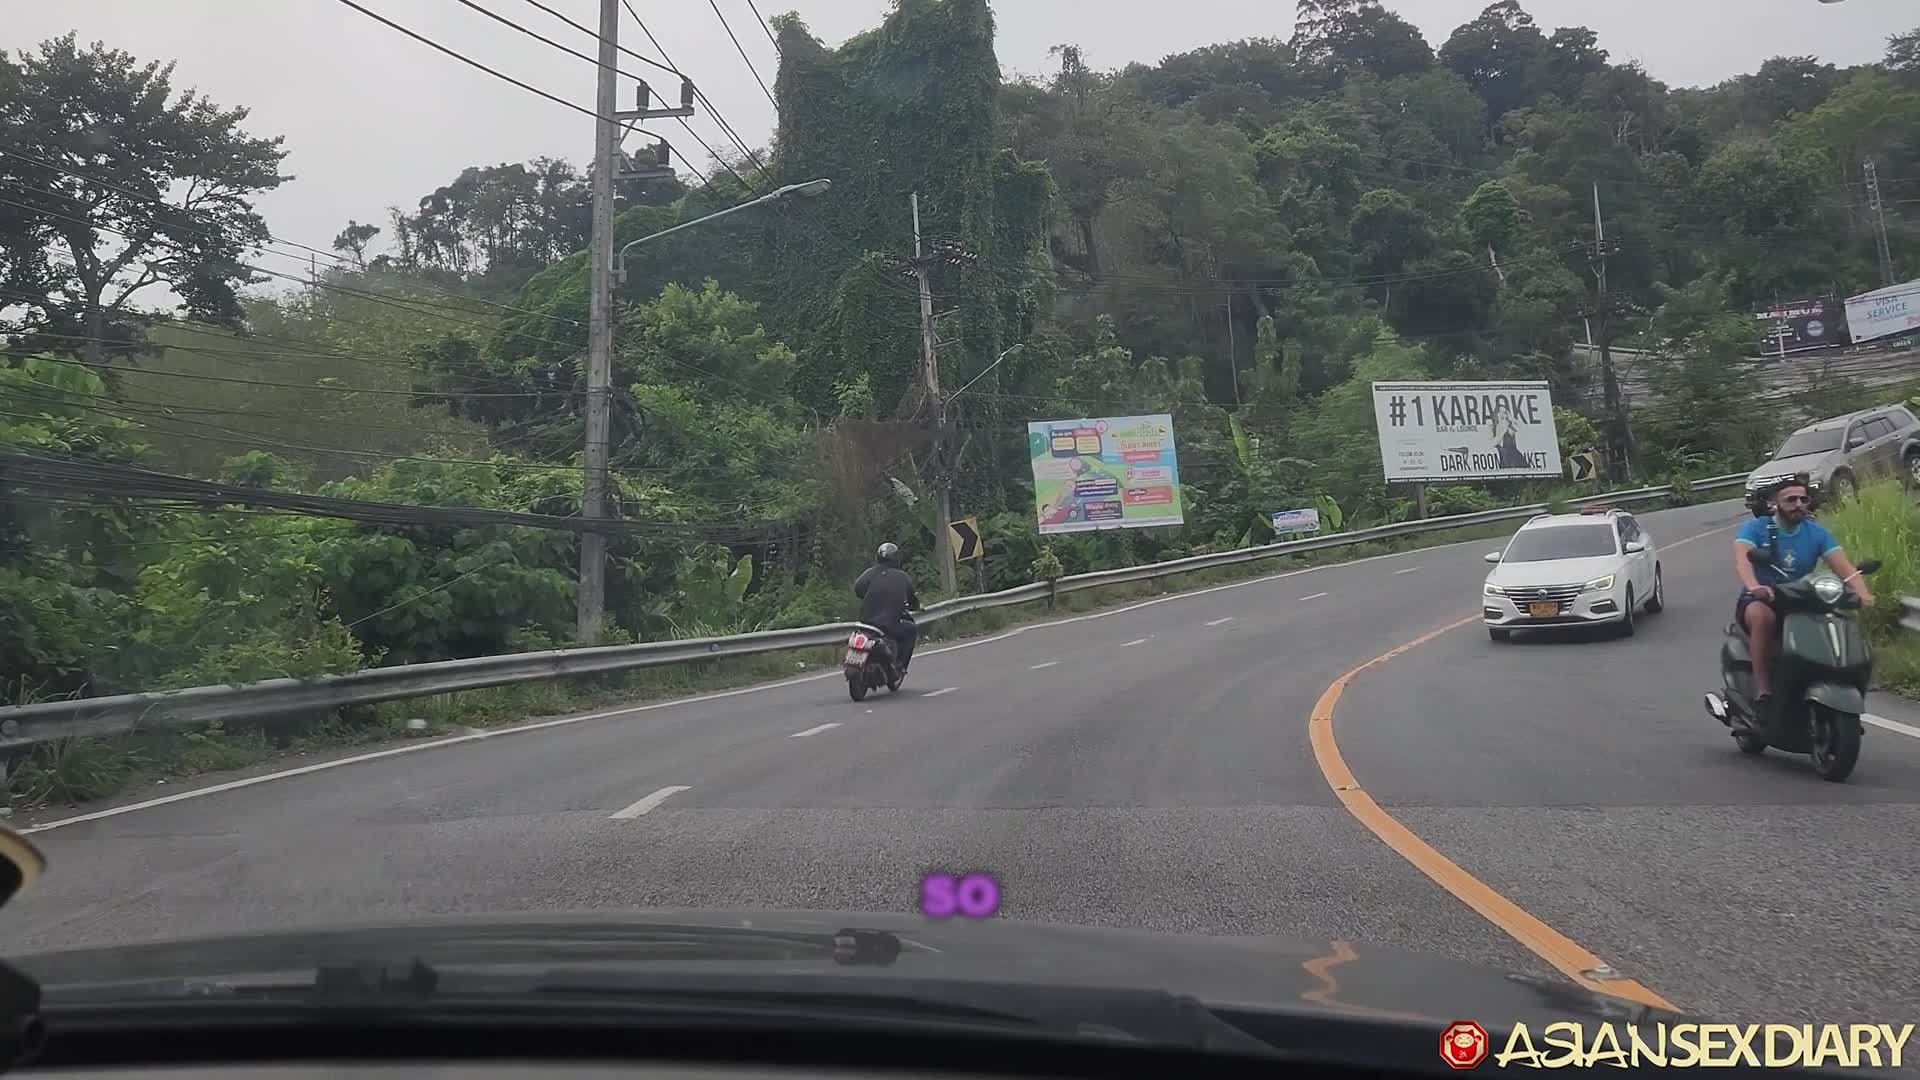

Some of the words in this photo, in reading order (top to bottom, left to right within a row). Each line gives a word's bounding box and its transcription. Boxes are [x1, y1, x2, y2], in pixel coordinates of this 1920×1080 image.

[1875, 296, 1898, 306] VISA
[1866, 303, 1907, 319] SERVICE
[1432, 394, 1542, 426] KARAOKE
[1440, 454, 1471, 471] DARK
